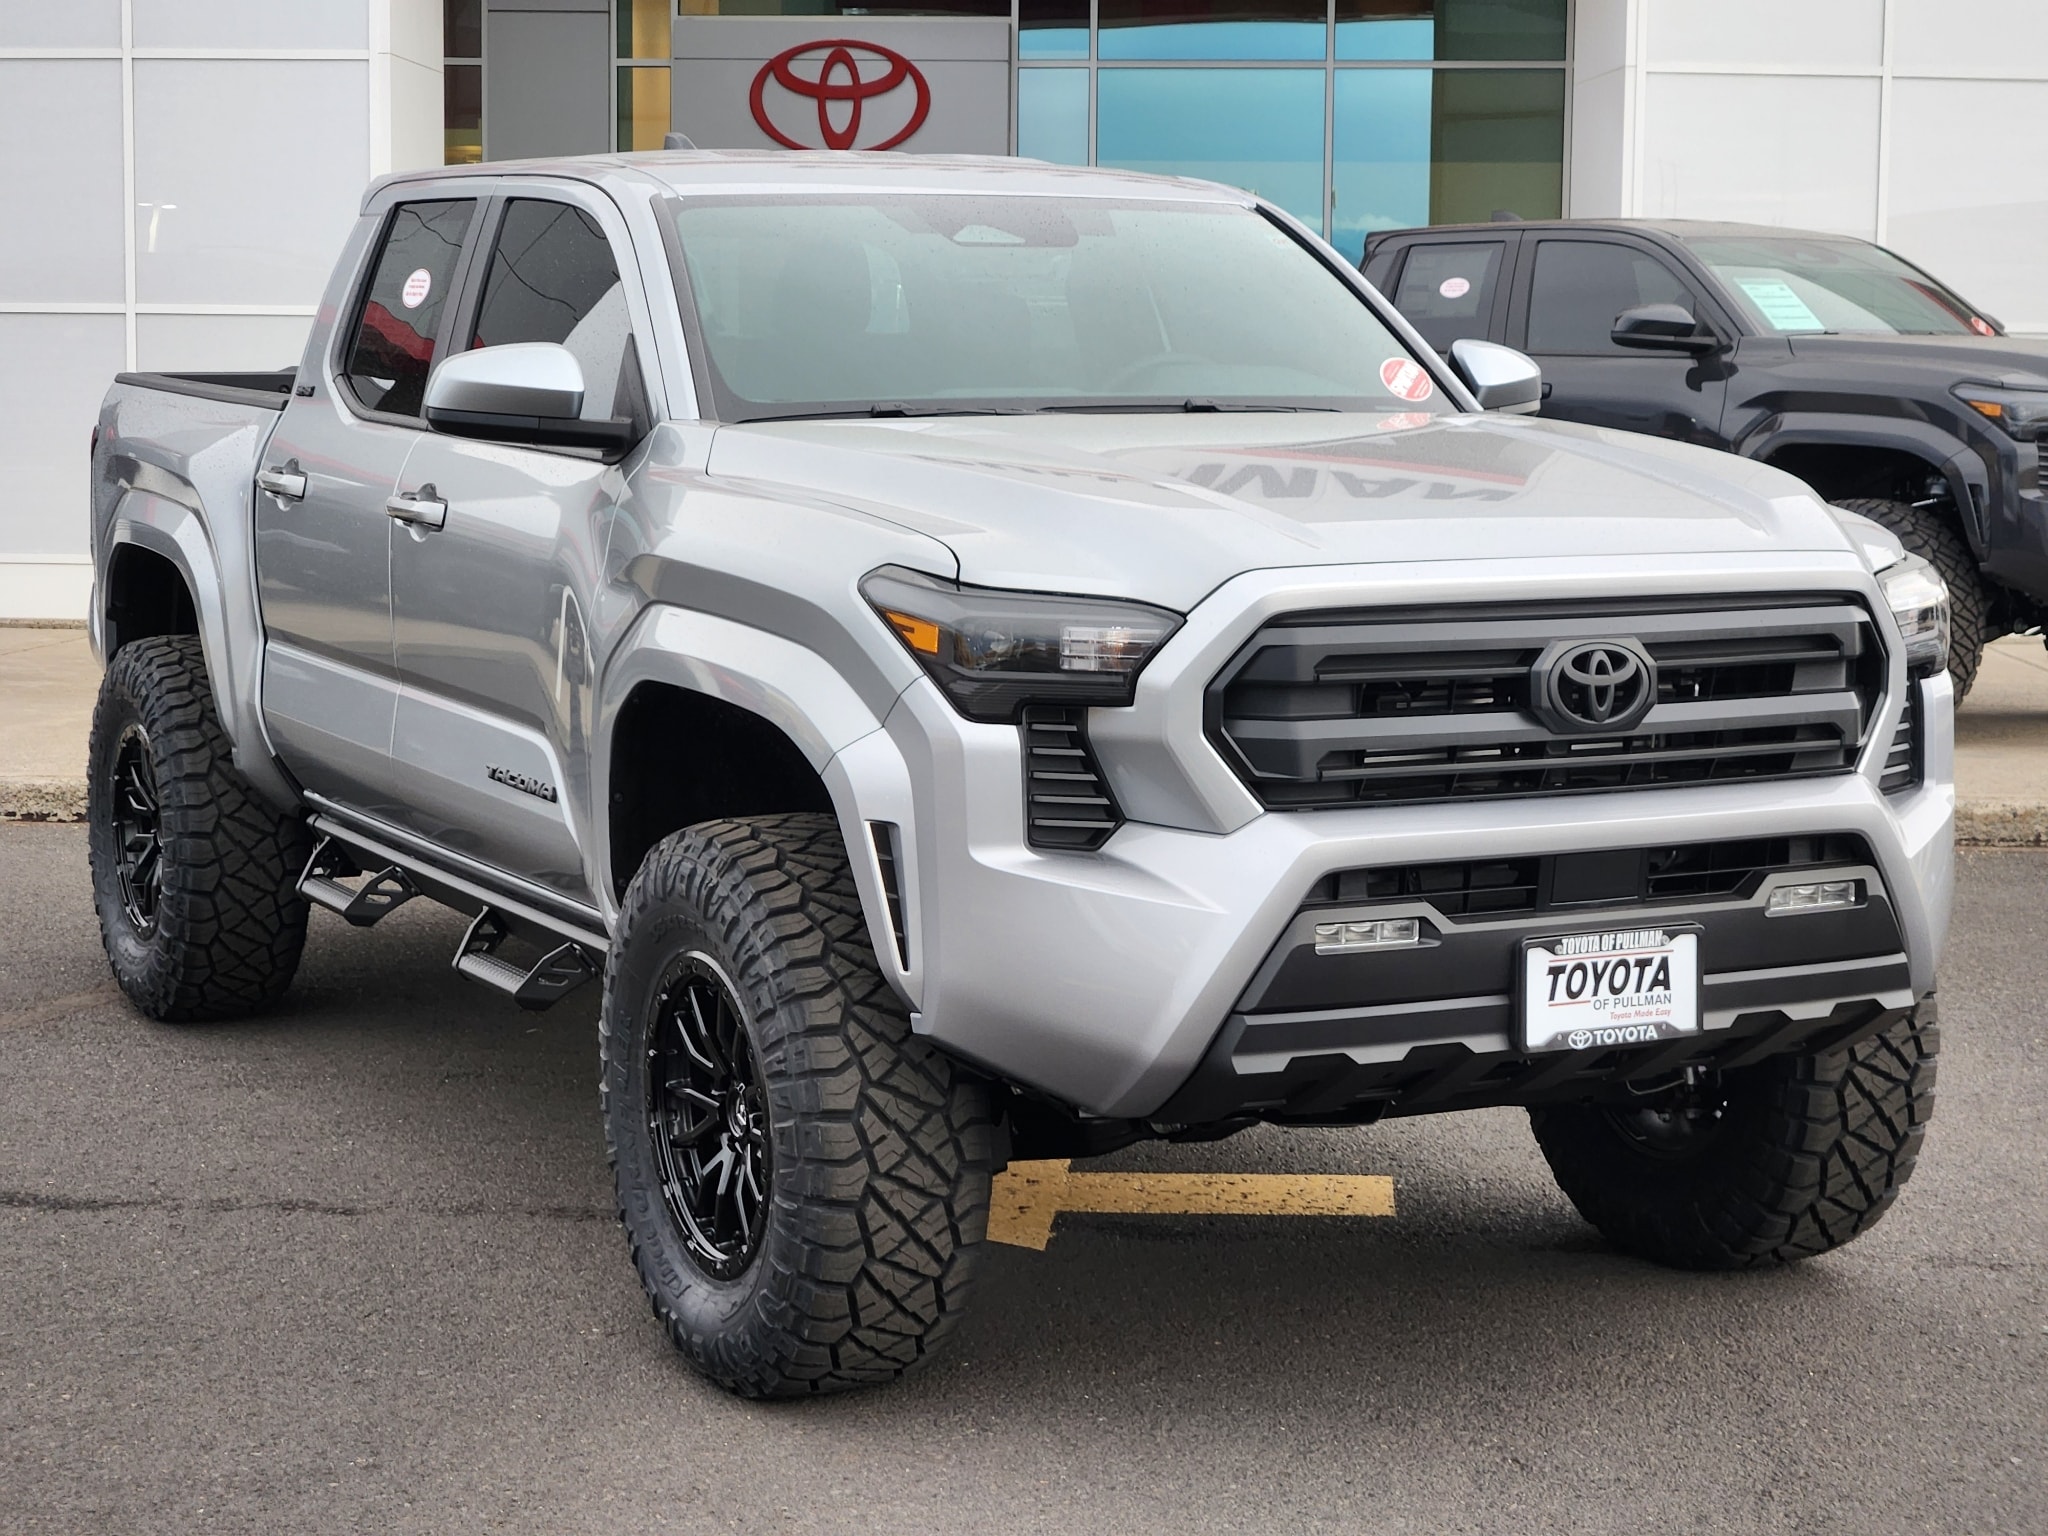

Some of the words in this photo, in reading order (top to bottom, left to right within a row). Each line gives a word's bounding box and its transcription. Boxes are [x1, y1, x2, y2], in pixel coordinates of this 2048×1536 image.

[485, 764, 557, 803] TACOMA
[1561, 935, 1600, 954] TOYOTA
[1602, 934, 1615, 952] OF
[1616, 930, 1663, 950] PULLMAN
[1546, 955, 1671, 1002] TOYOTA
[1593, 998, 1610, 1011] OF
[1613, 993, 1672, 1009] PULLMAN
[1610, 1011, 1632, 1021] Toyota
[1633, 1009, 1654, 1018] Made
[1655, 1008, 1672, 1018] Easy
[1593, 1025, 1658, 1046] TOYOTA
